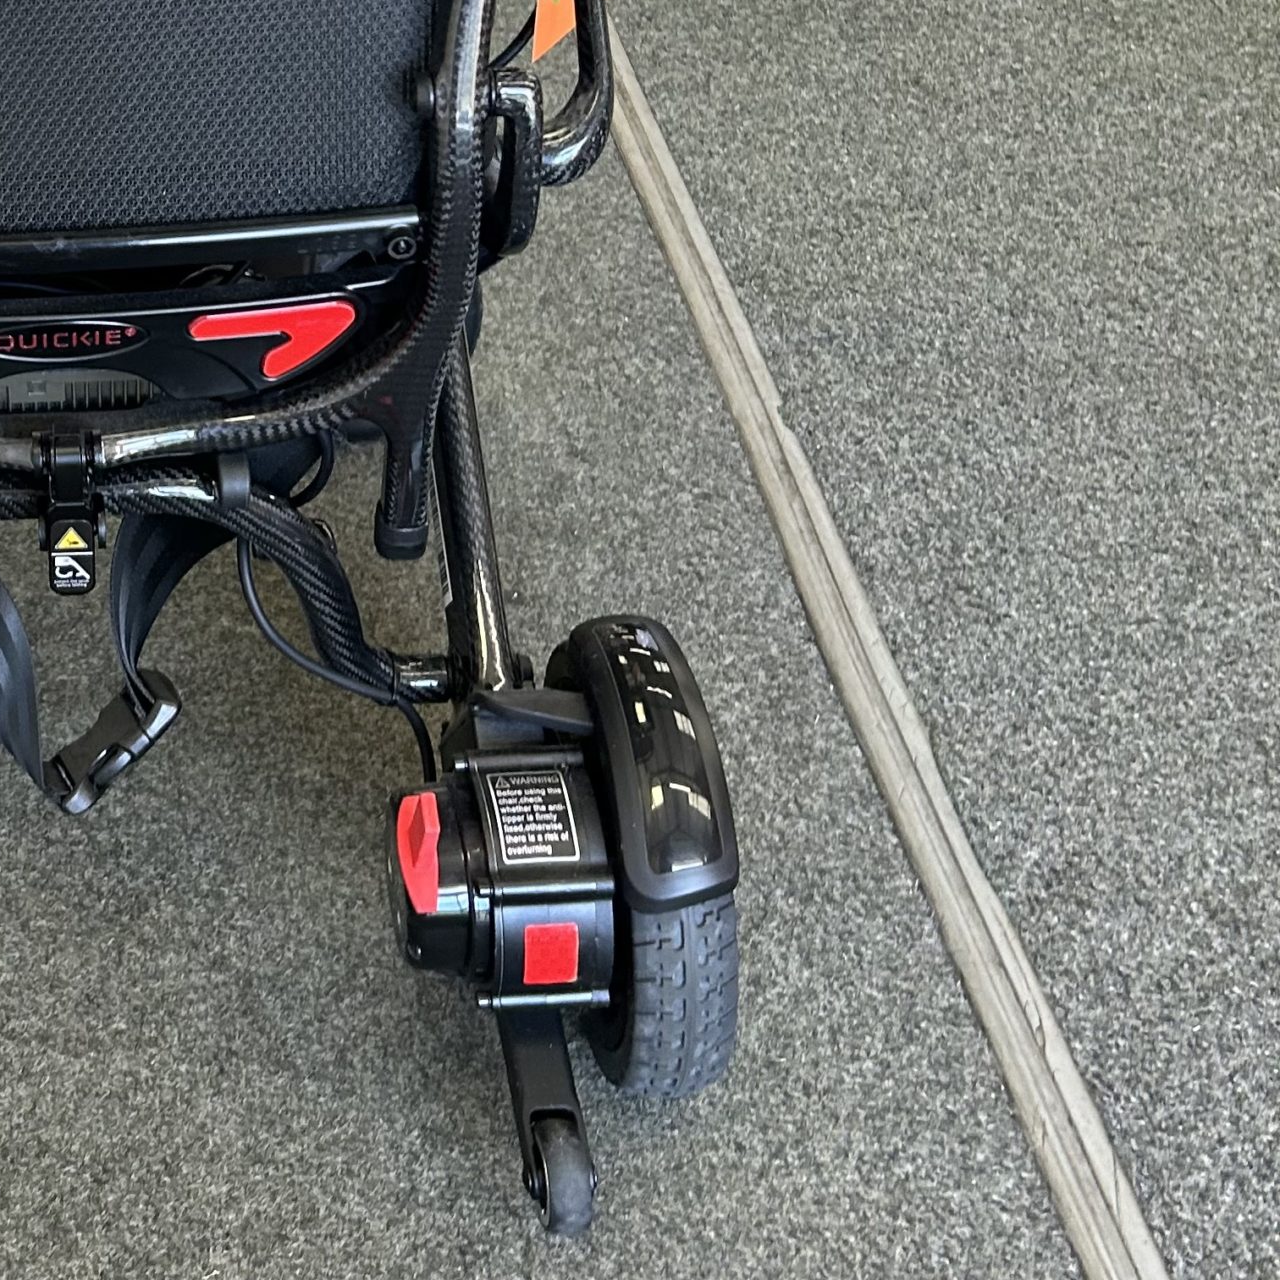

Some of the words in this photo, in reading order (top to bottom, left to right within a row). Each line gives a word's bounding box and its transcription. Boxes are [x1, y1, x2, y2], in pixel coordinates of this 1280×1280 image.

[509, 775, 559, 784] WARNING
[533, 804, 546, 812] the
[505, 834, 526, 844] there
[527, 833, 535, 842] is
[544, 832, 559, 841] risk
[560, 831, 569, 841] of
[507, 844, 552, 855] overturning
